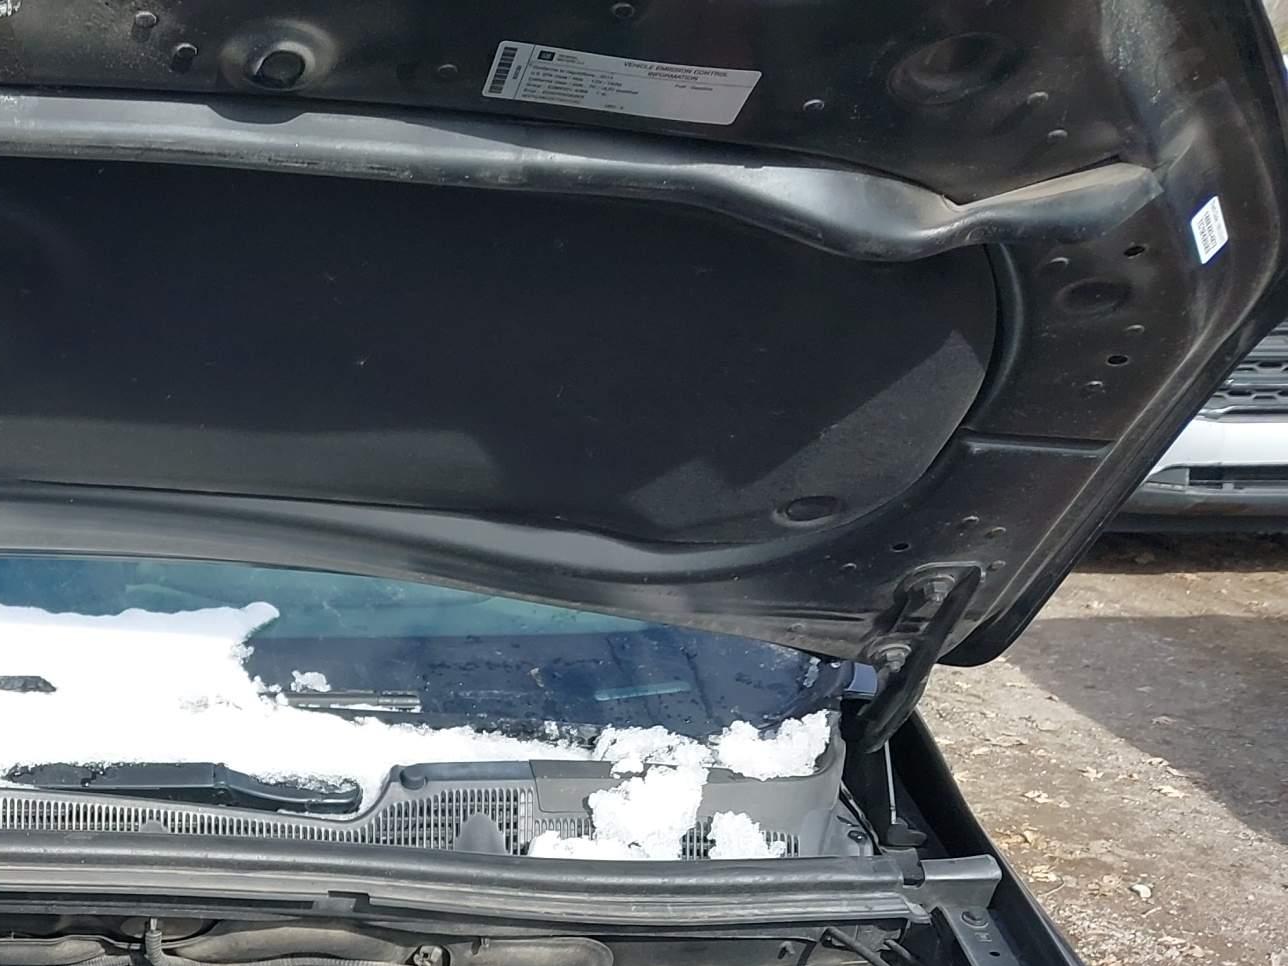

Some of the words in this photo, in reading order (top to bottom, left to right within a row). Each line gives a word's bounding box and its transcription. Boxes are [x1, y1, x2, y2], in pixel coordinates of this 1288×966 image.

[623, 61, 654, 72] VEHICLE
[655, 65, 693, 75] EMISSION
[693, 69, 728, 78] CONTROL
[647, 71, 699, 81] INFORMATION
